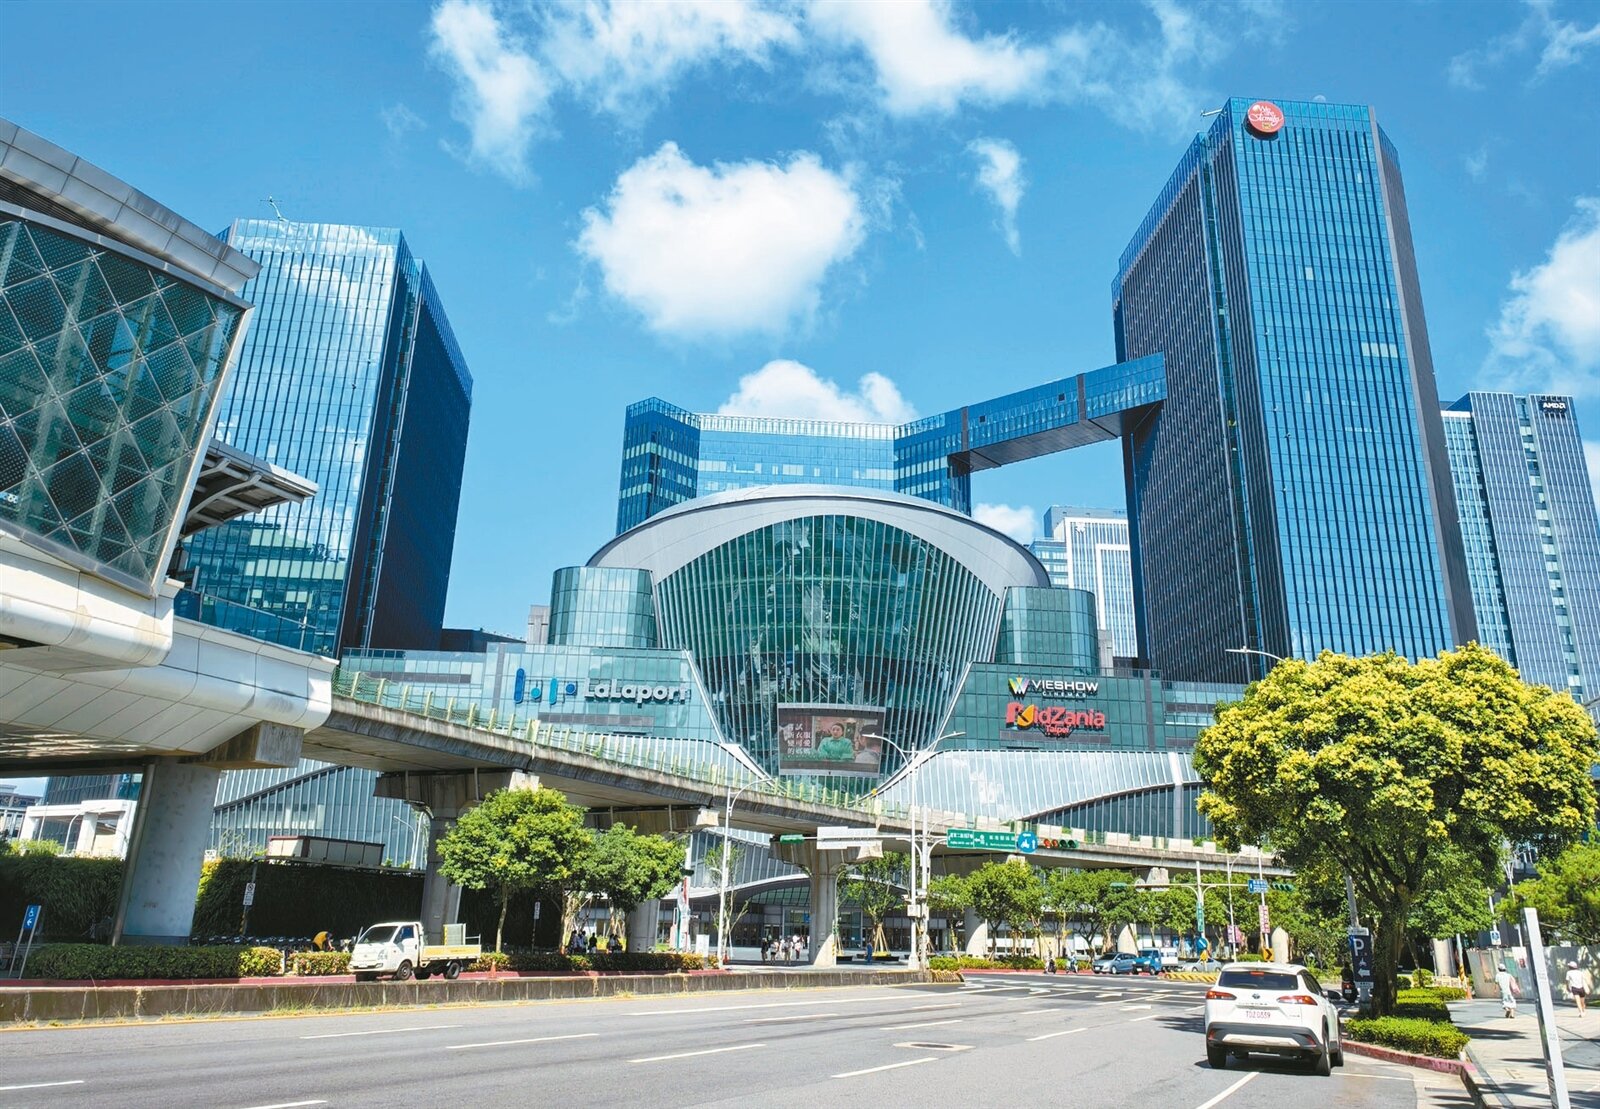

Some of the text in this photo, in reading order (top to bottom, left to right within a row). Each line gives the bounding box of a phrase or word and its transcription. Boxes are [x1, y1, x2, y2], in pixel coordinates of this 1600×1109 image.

[584, 678, 691, 705] LaLaport
[1031, 679, 1099, 691] VIESHOW
[1006, 701, 1106, 728] KidZania
[1045, 725, 1070, 735] Taipei
[1353, 938, 1365, 956] P
